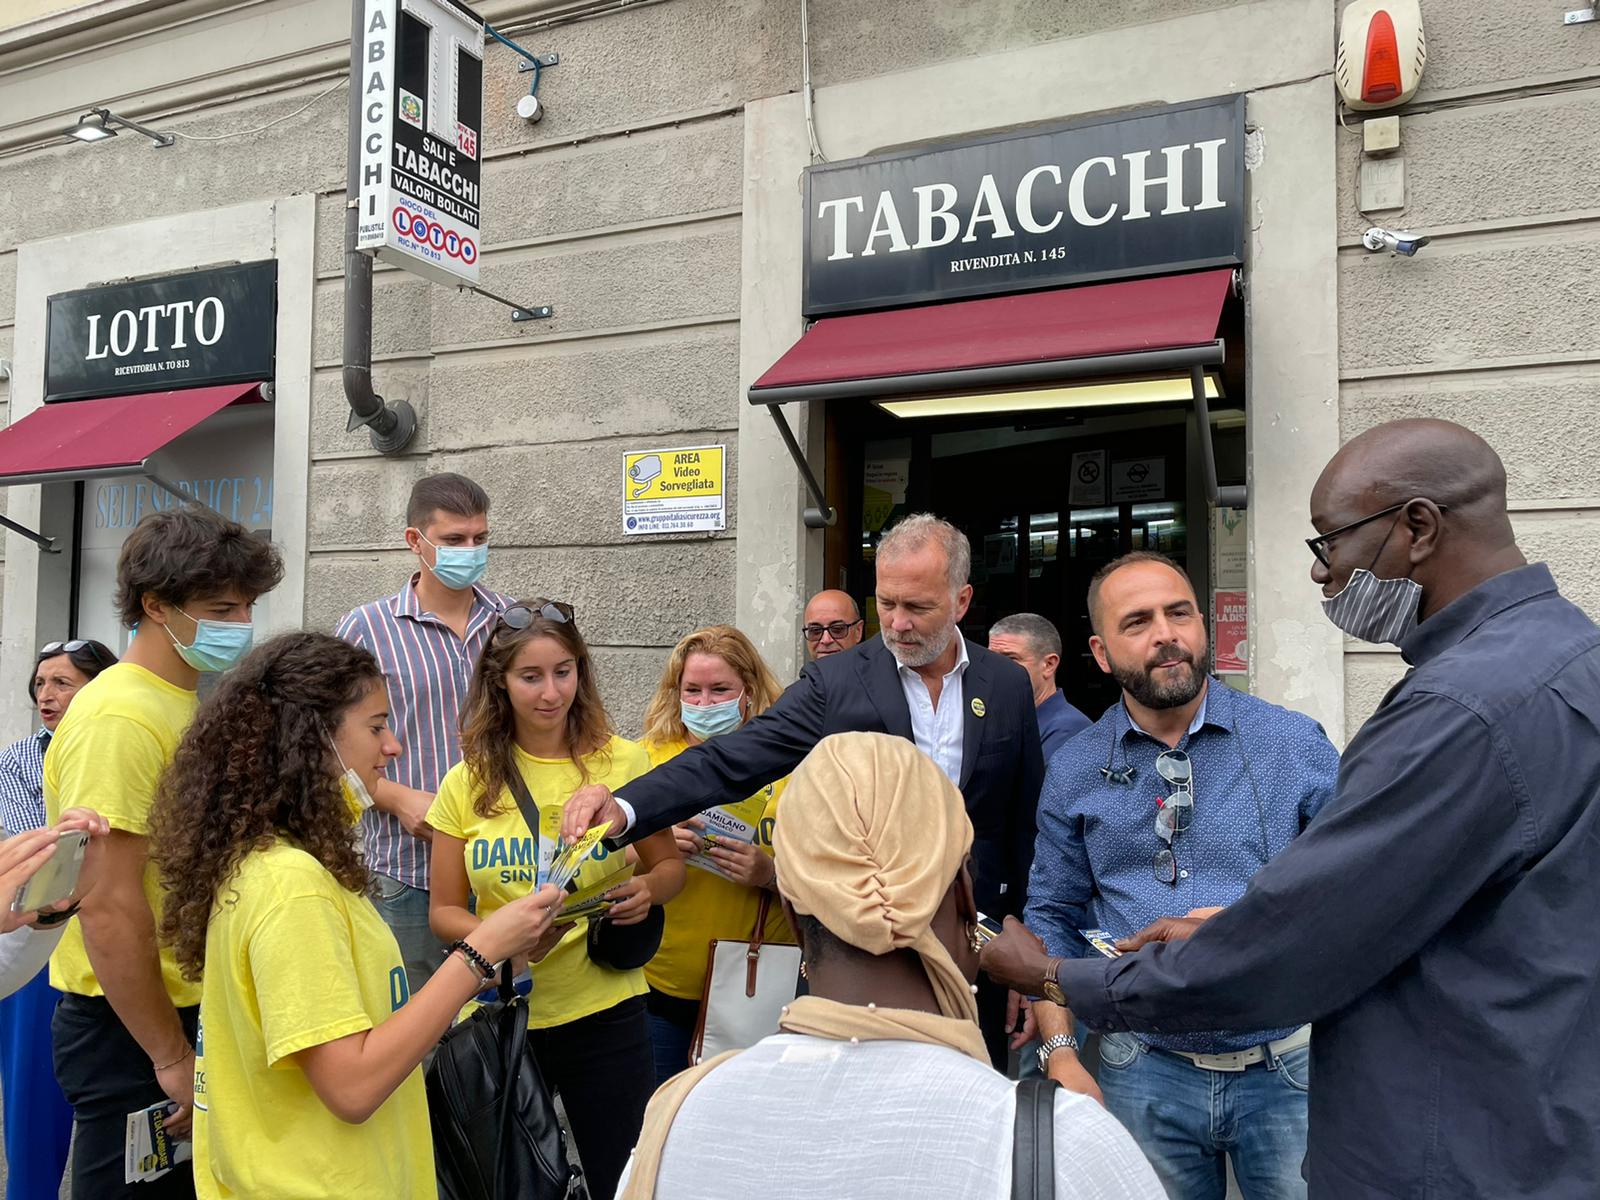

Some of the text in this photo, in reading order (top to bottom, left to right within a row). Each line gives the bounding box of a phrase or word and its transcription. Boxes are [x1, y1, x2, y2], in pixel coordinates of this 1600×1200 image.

[422, 137, 456, 167] SALI E
[458, 132, 476, 158] 145
[395, 142, 479, 206] TABACCHI
[394, 173, 478, 226] VALORI BOLLATI
[399, 197, 438, 221] GIOCO DEL
[818, 138, 1227, 262] TABACCHI
[395, 208, 475, 262] LOTTO
[950, 246, 1066, 273] RIVENDITA N. 145
[85, 296, 225, 360] LOTTO
[114, 359, 190, 376] RICEVITORIA N. TO 813
[674, 453, 700, 465] AREA
[660, 479, 715, 492] Sorvegliata
[673, 467, 700, 478] Video
[96, 482, 147, 529] SELF
[700, 809, 747, 832] DAMILANO
[708, 819, 734, 833] SINDACO
